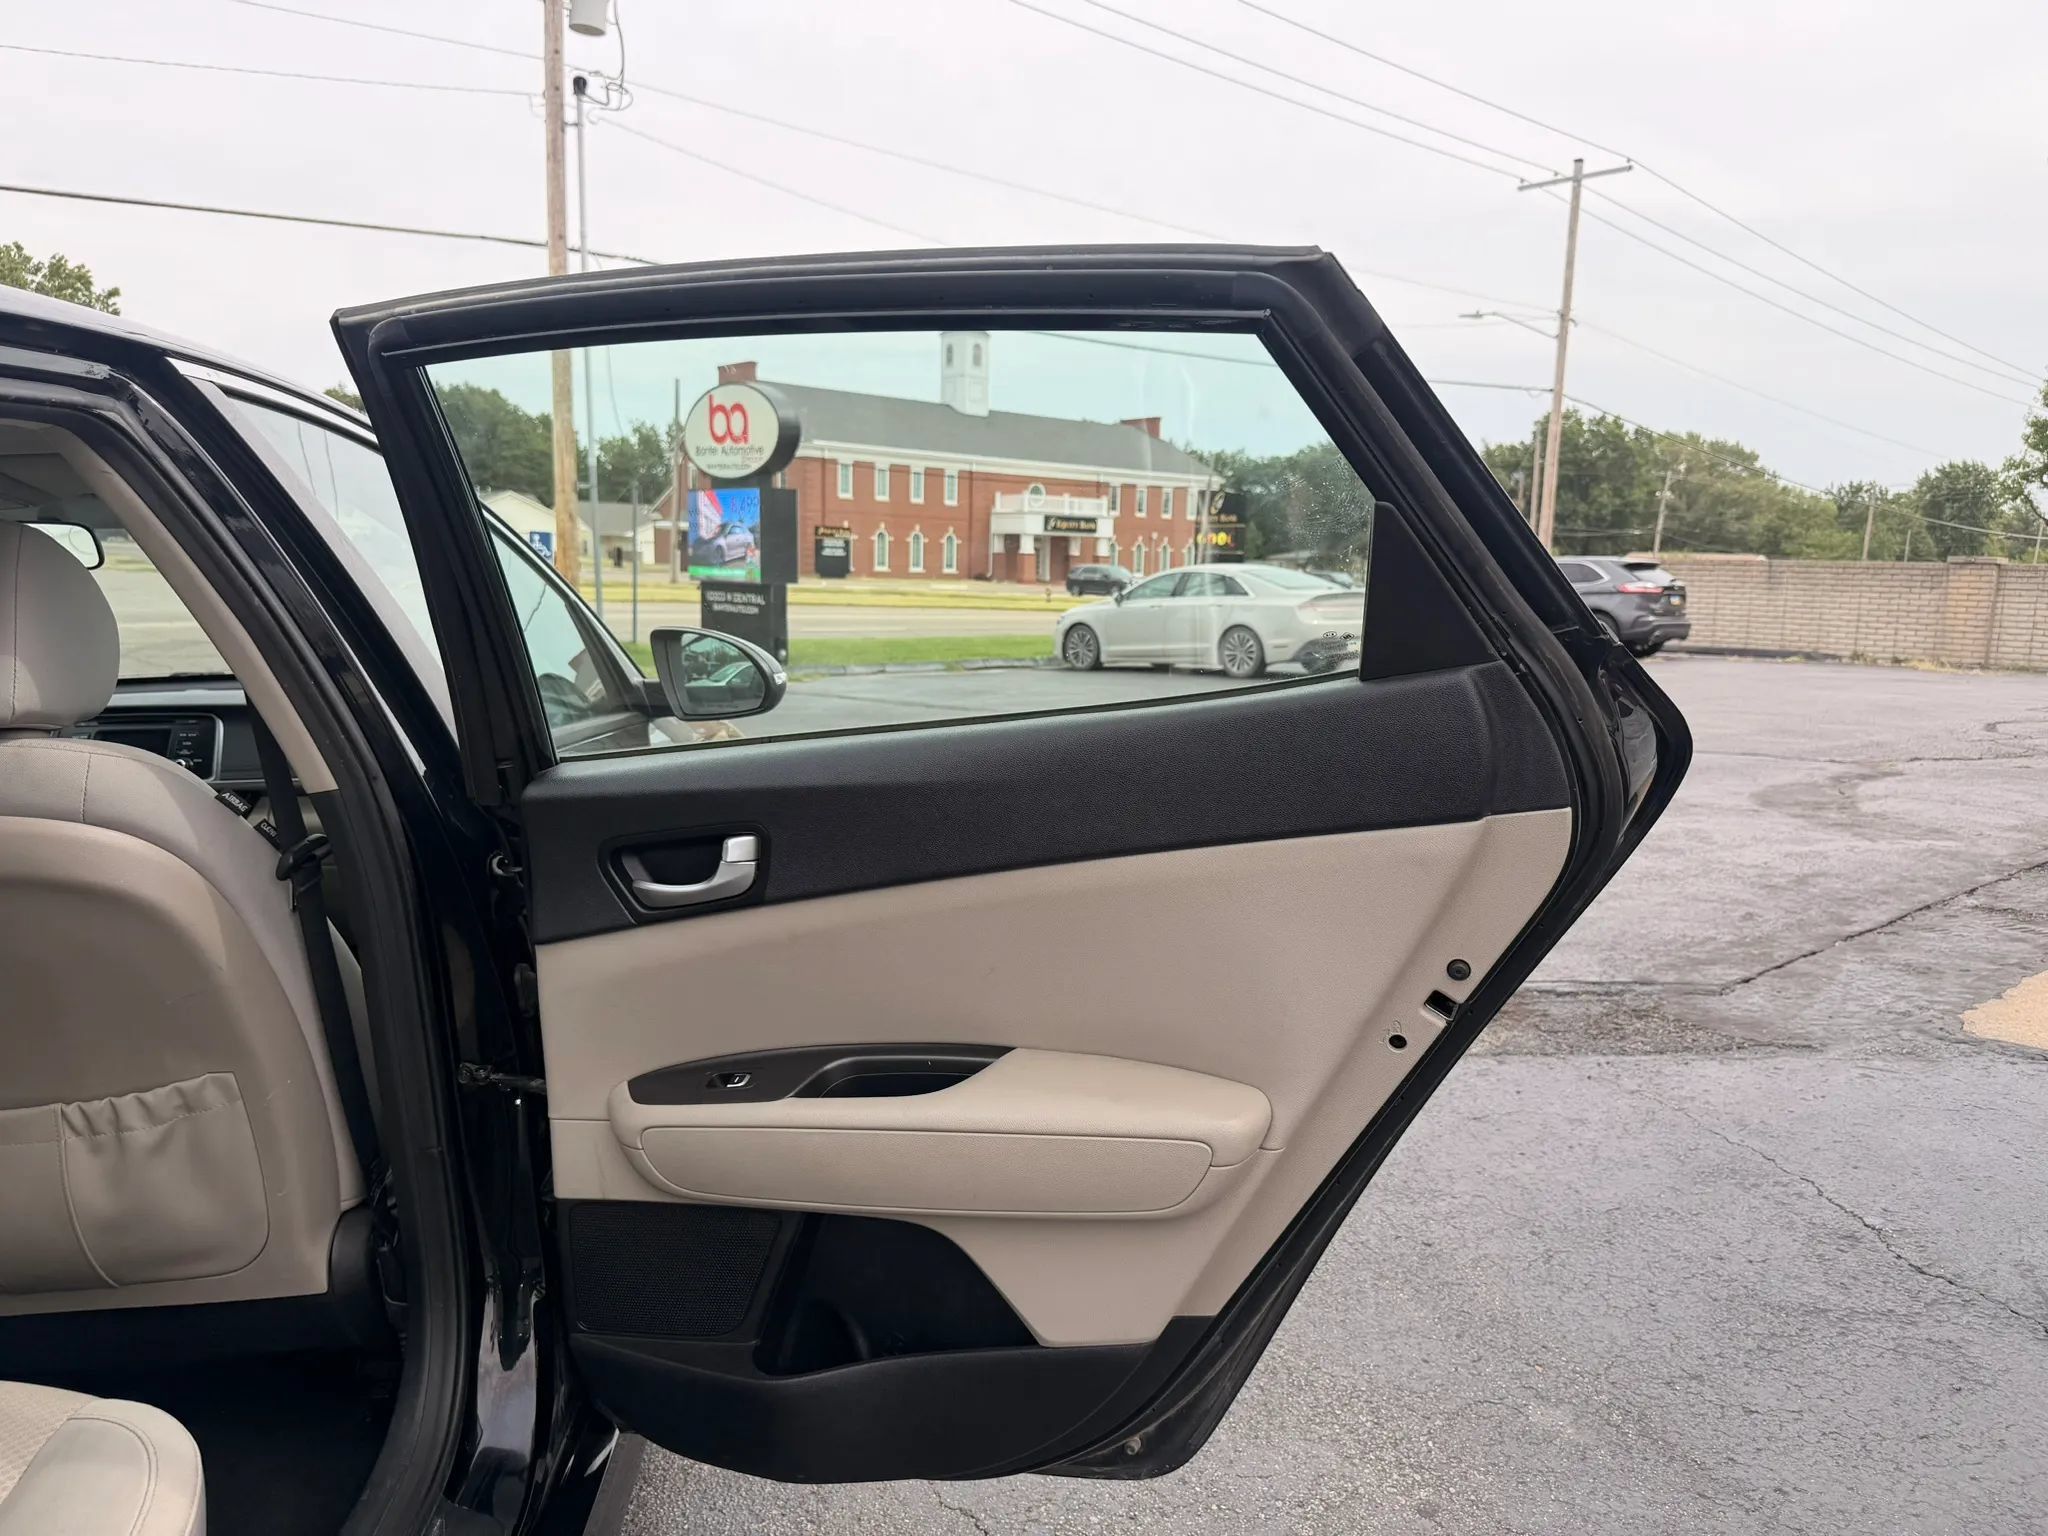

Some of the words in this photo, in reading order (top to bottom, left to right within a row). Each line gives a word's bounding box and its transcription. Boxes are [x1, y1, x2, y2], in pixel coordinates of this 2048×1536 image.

[721, 446, 764, 457] Automotive
[733, 592, 766, 605] CENTRAL
[221, 792, 248, 812] AIRBAG
